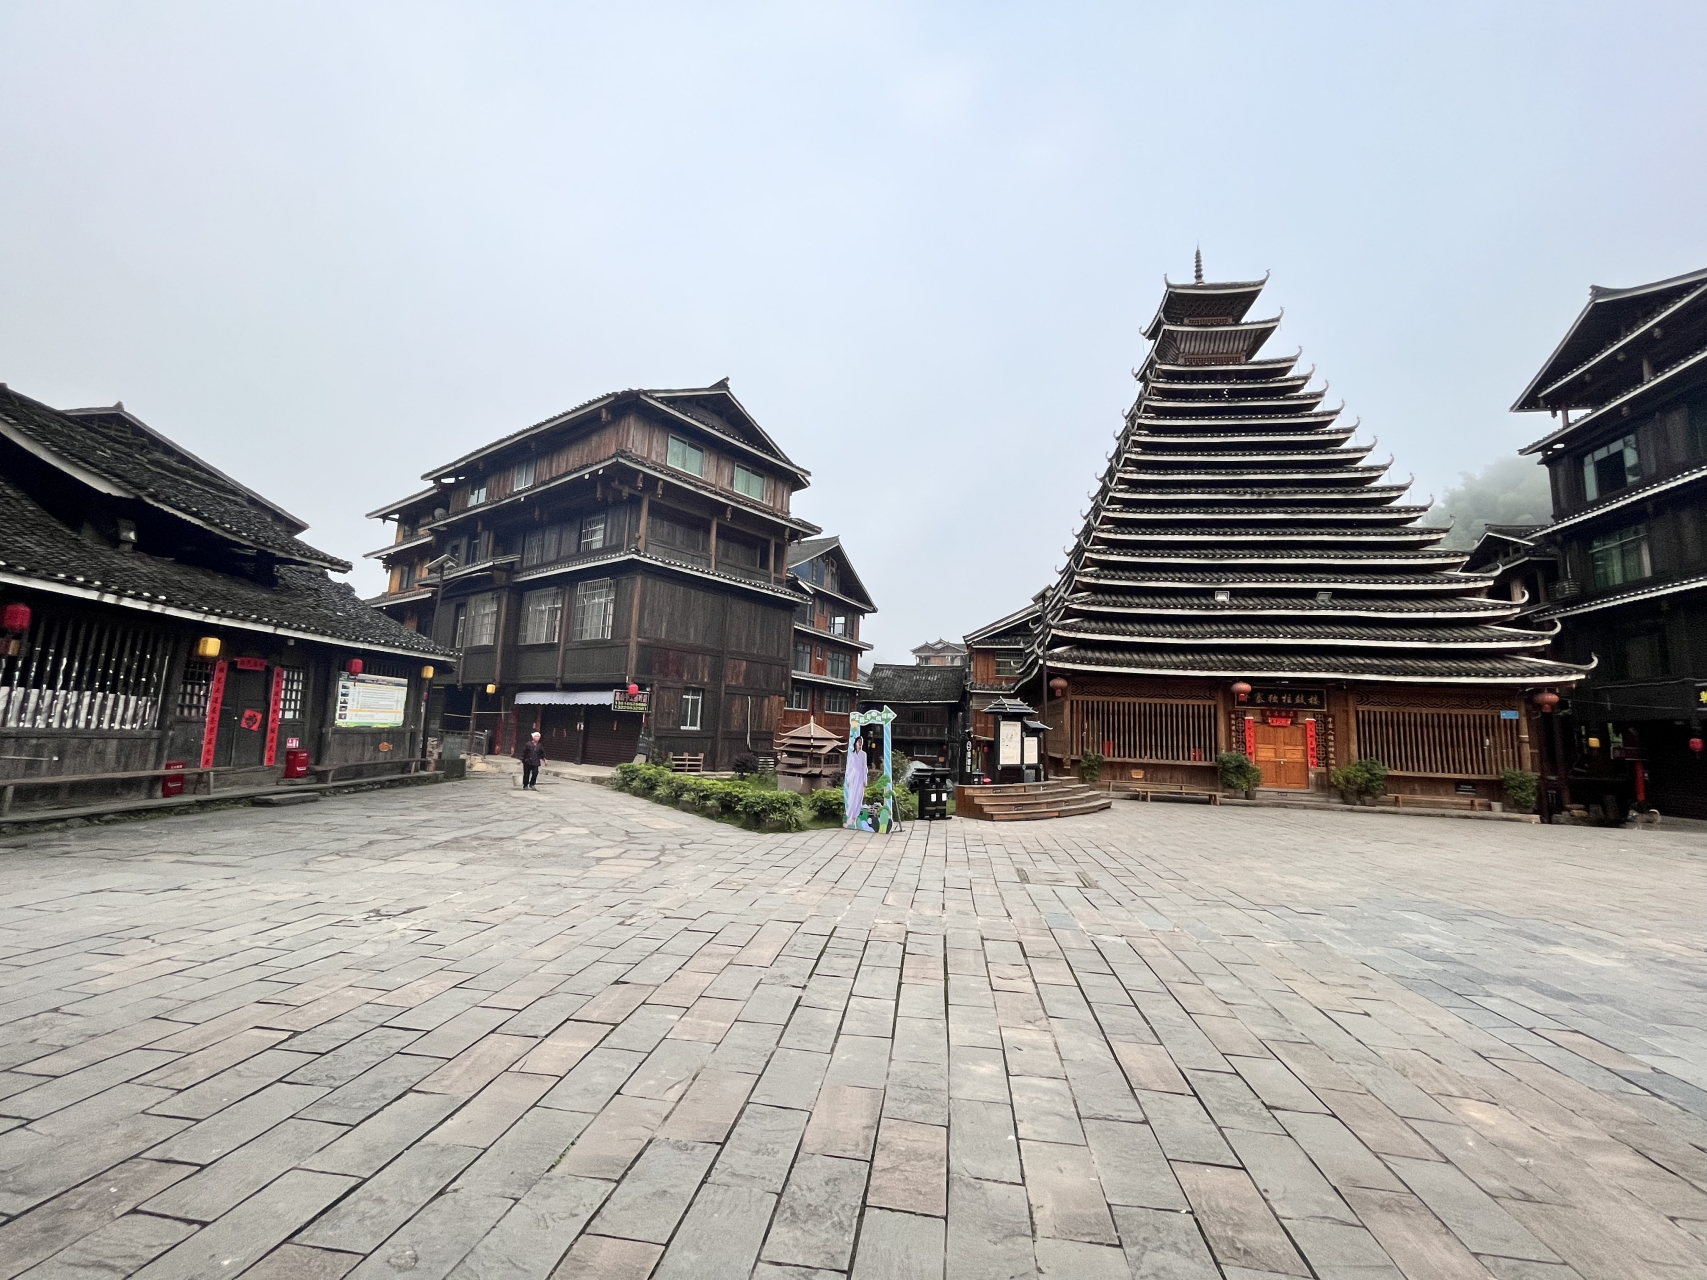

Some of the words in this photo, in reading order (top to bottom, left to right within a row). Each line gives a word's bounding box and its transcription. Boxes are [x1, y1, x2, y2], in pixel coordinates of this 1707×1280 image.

[1246, 692, 1320, 705] 寨独柱鼓楼
